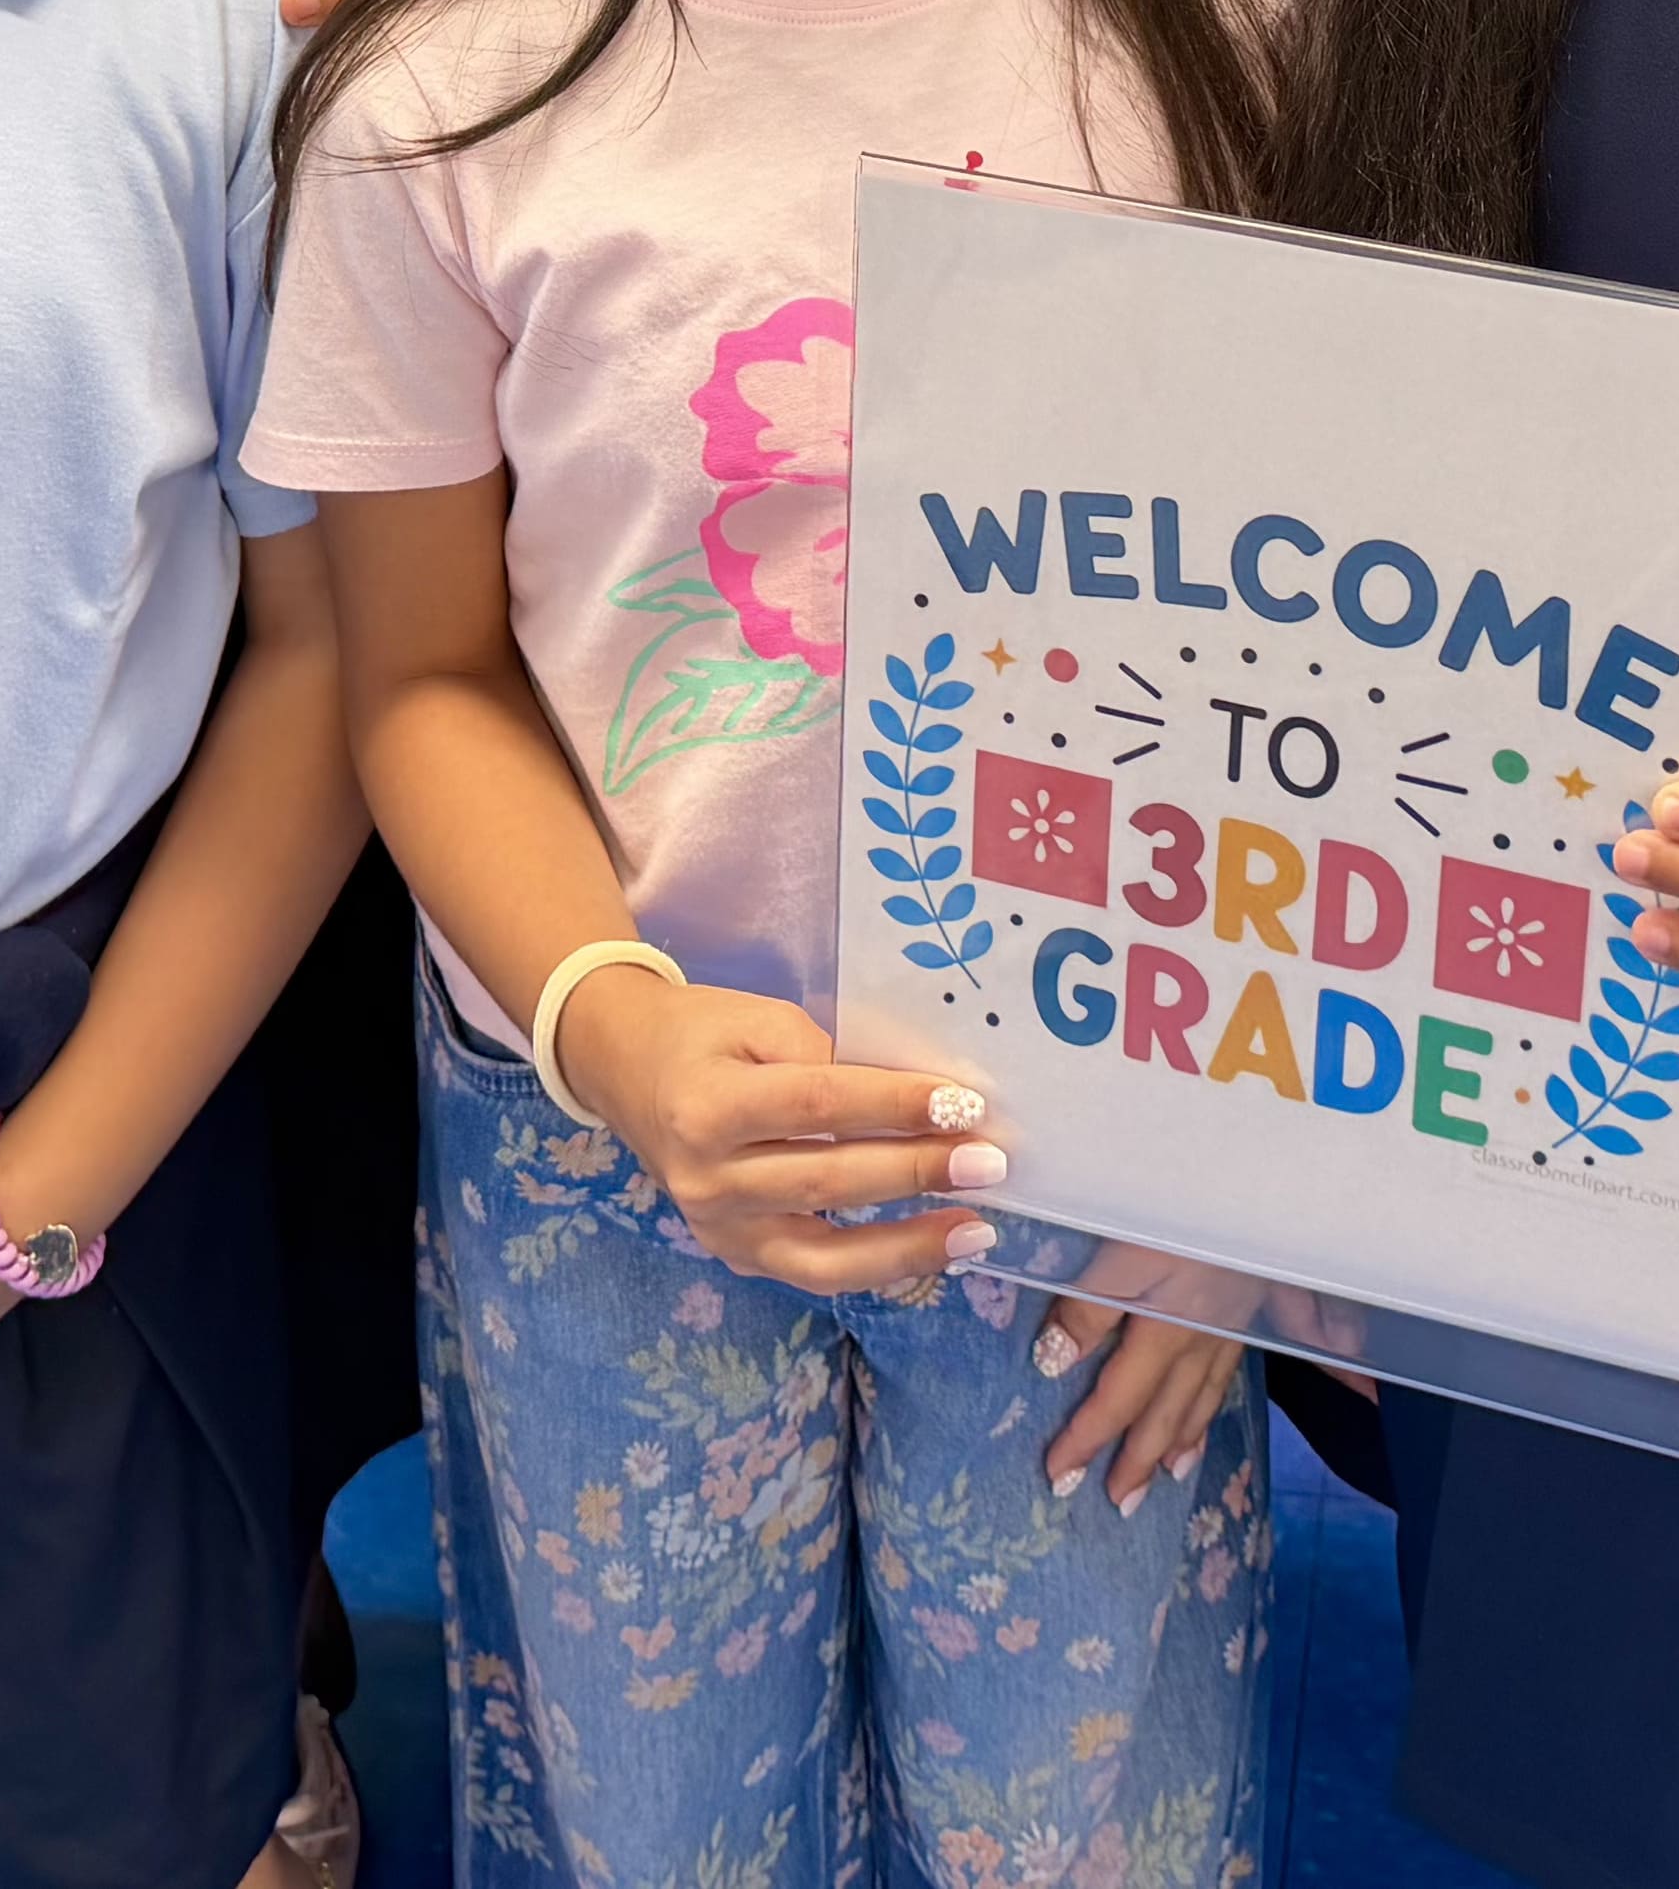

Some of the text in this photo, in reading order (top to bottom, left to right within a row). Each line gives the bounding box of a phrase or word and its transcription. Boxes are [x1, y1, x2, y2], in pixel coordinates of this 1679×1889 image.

[1209, 698, 1341, 799] TO
[1121, 801, 1409, 973] 3RD
[1031, 928, 1496, 1148] GRADE
